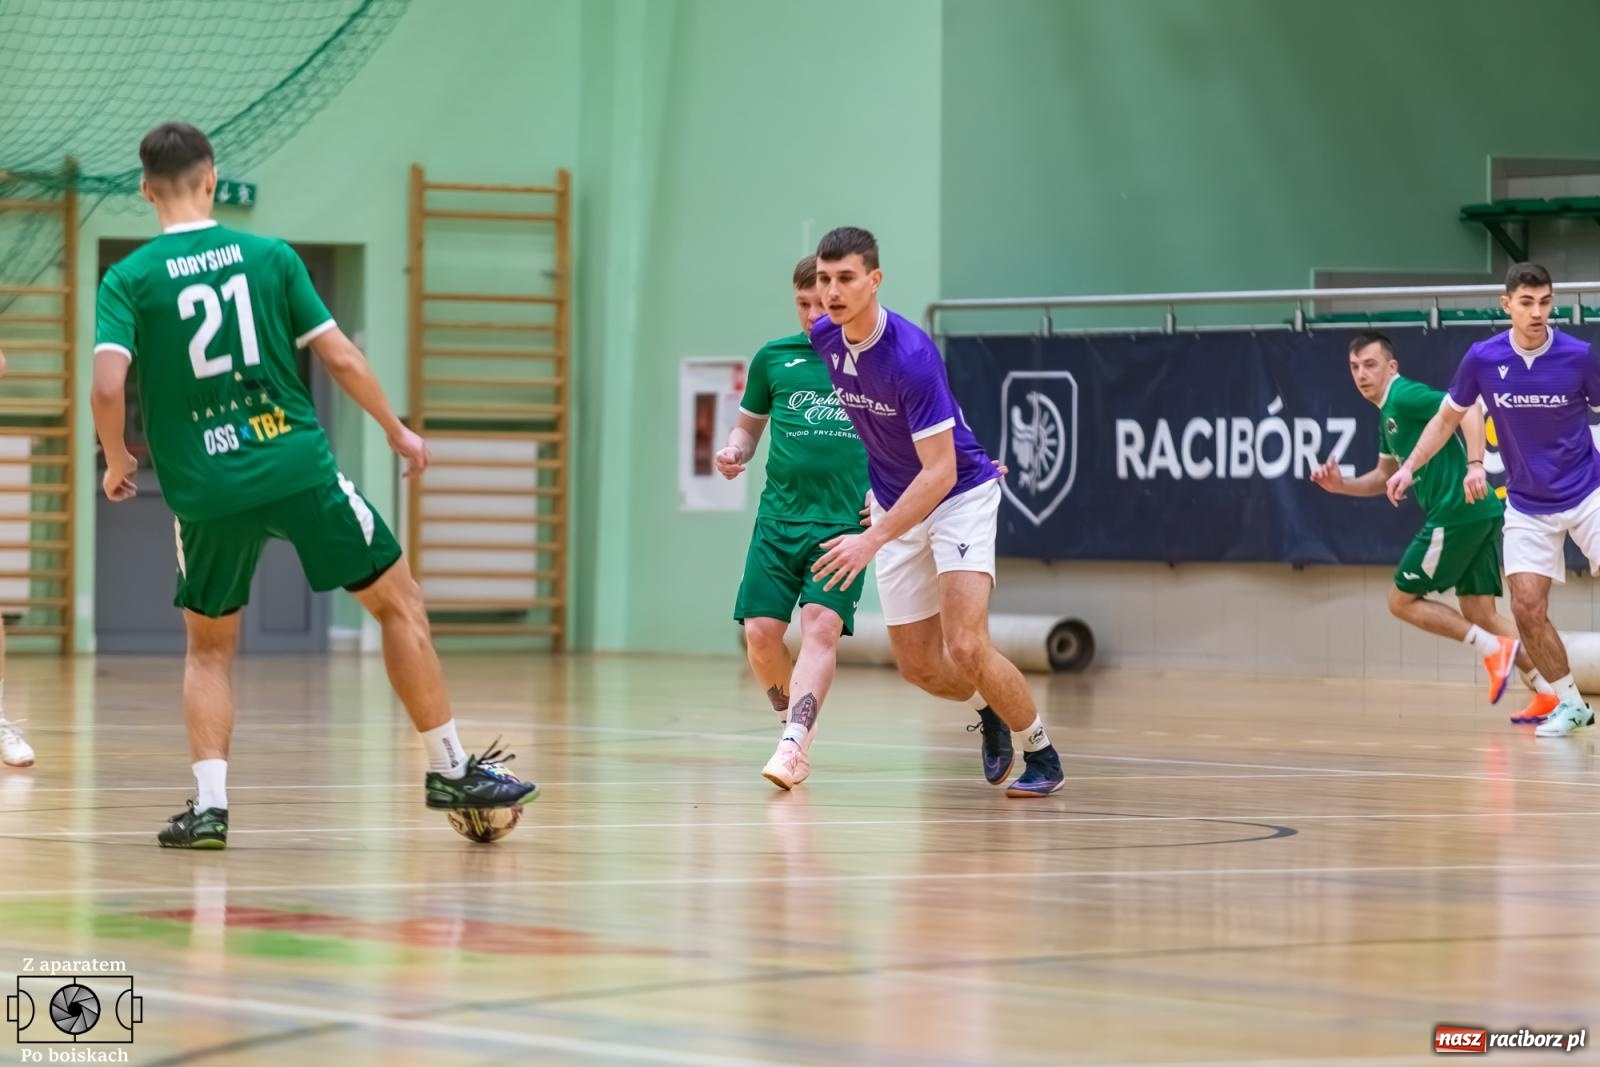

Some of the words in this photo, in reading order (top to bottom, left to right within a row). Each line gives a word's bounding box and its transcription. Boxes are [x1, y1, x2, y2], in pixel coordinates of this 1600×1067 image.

[177, 273, 260, 379] 21
[203, 423, 240, 456] OSG
[813, 429, 861, 440] FRYZJERSKI
[1115, 395, 1357, 479] RACIBÓRZ
